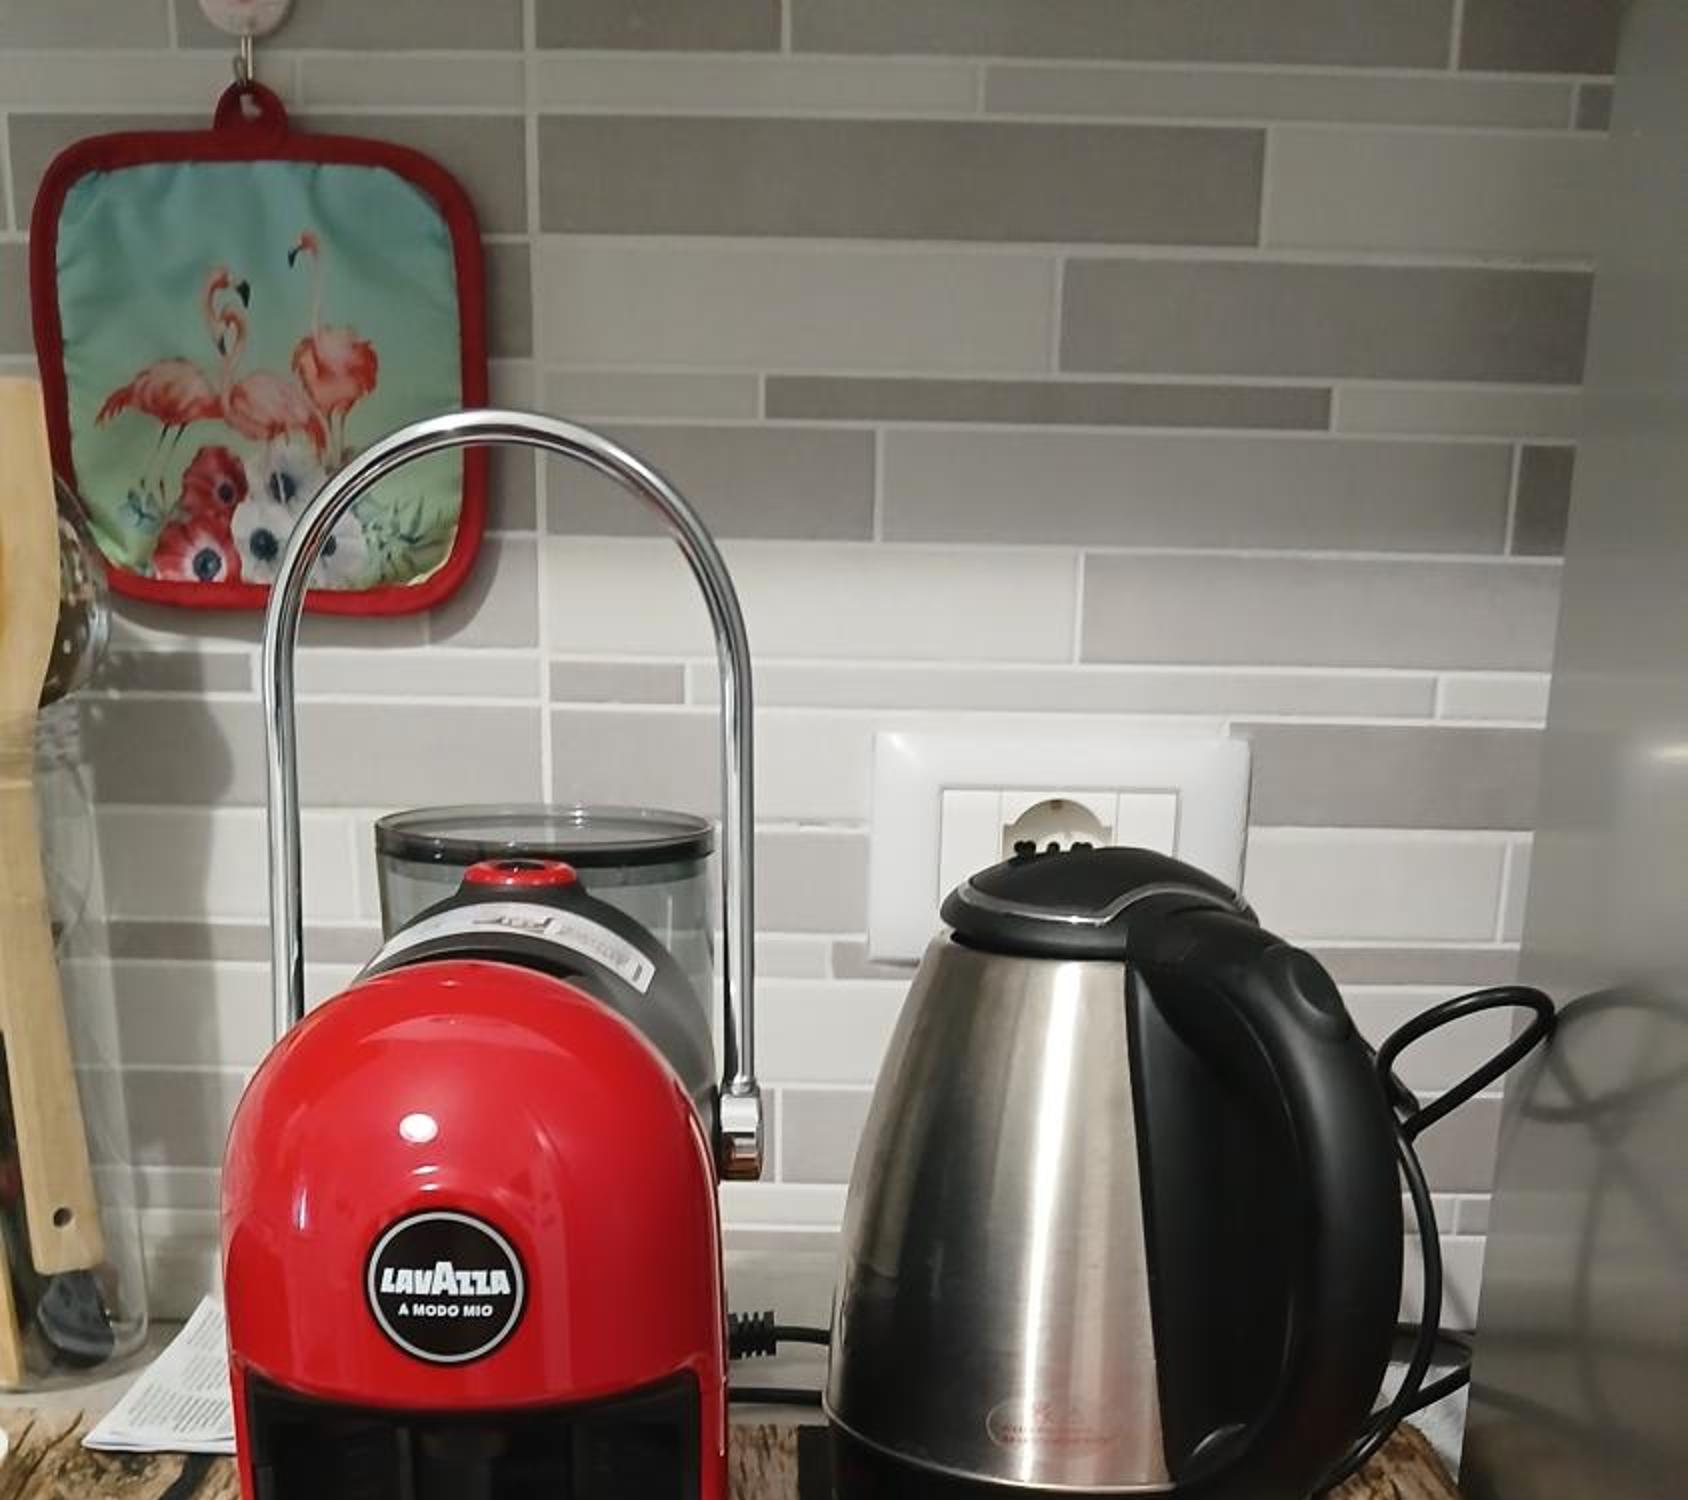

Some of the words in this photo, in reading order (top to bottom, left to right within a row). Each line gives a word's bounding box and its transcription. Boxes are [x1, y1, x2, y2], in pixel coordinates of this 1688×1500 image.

[380, 1261, 511, 1295] LAVAZZA
[398, 1303, 409, 1315] A
[413, 1304, 459, 1317] MODO
[463, 1305, 493, 1317] MIO
